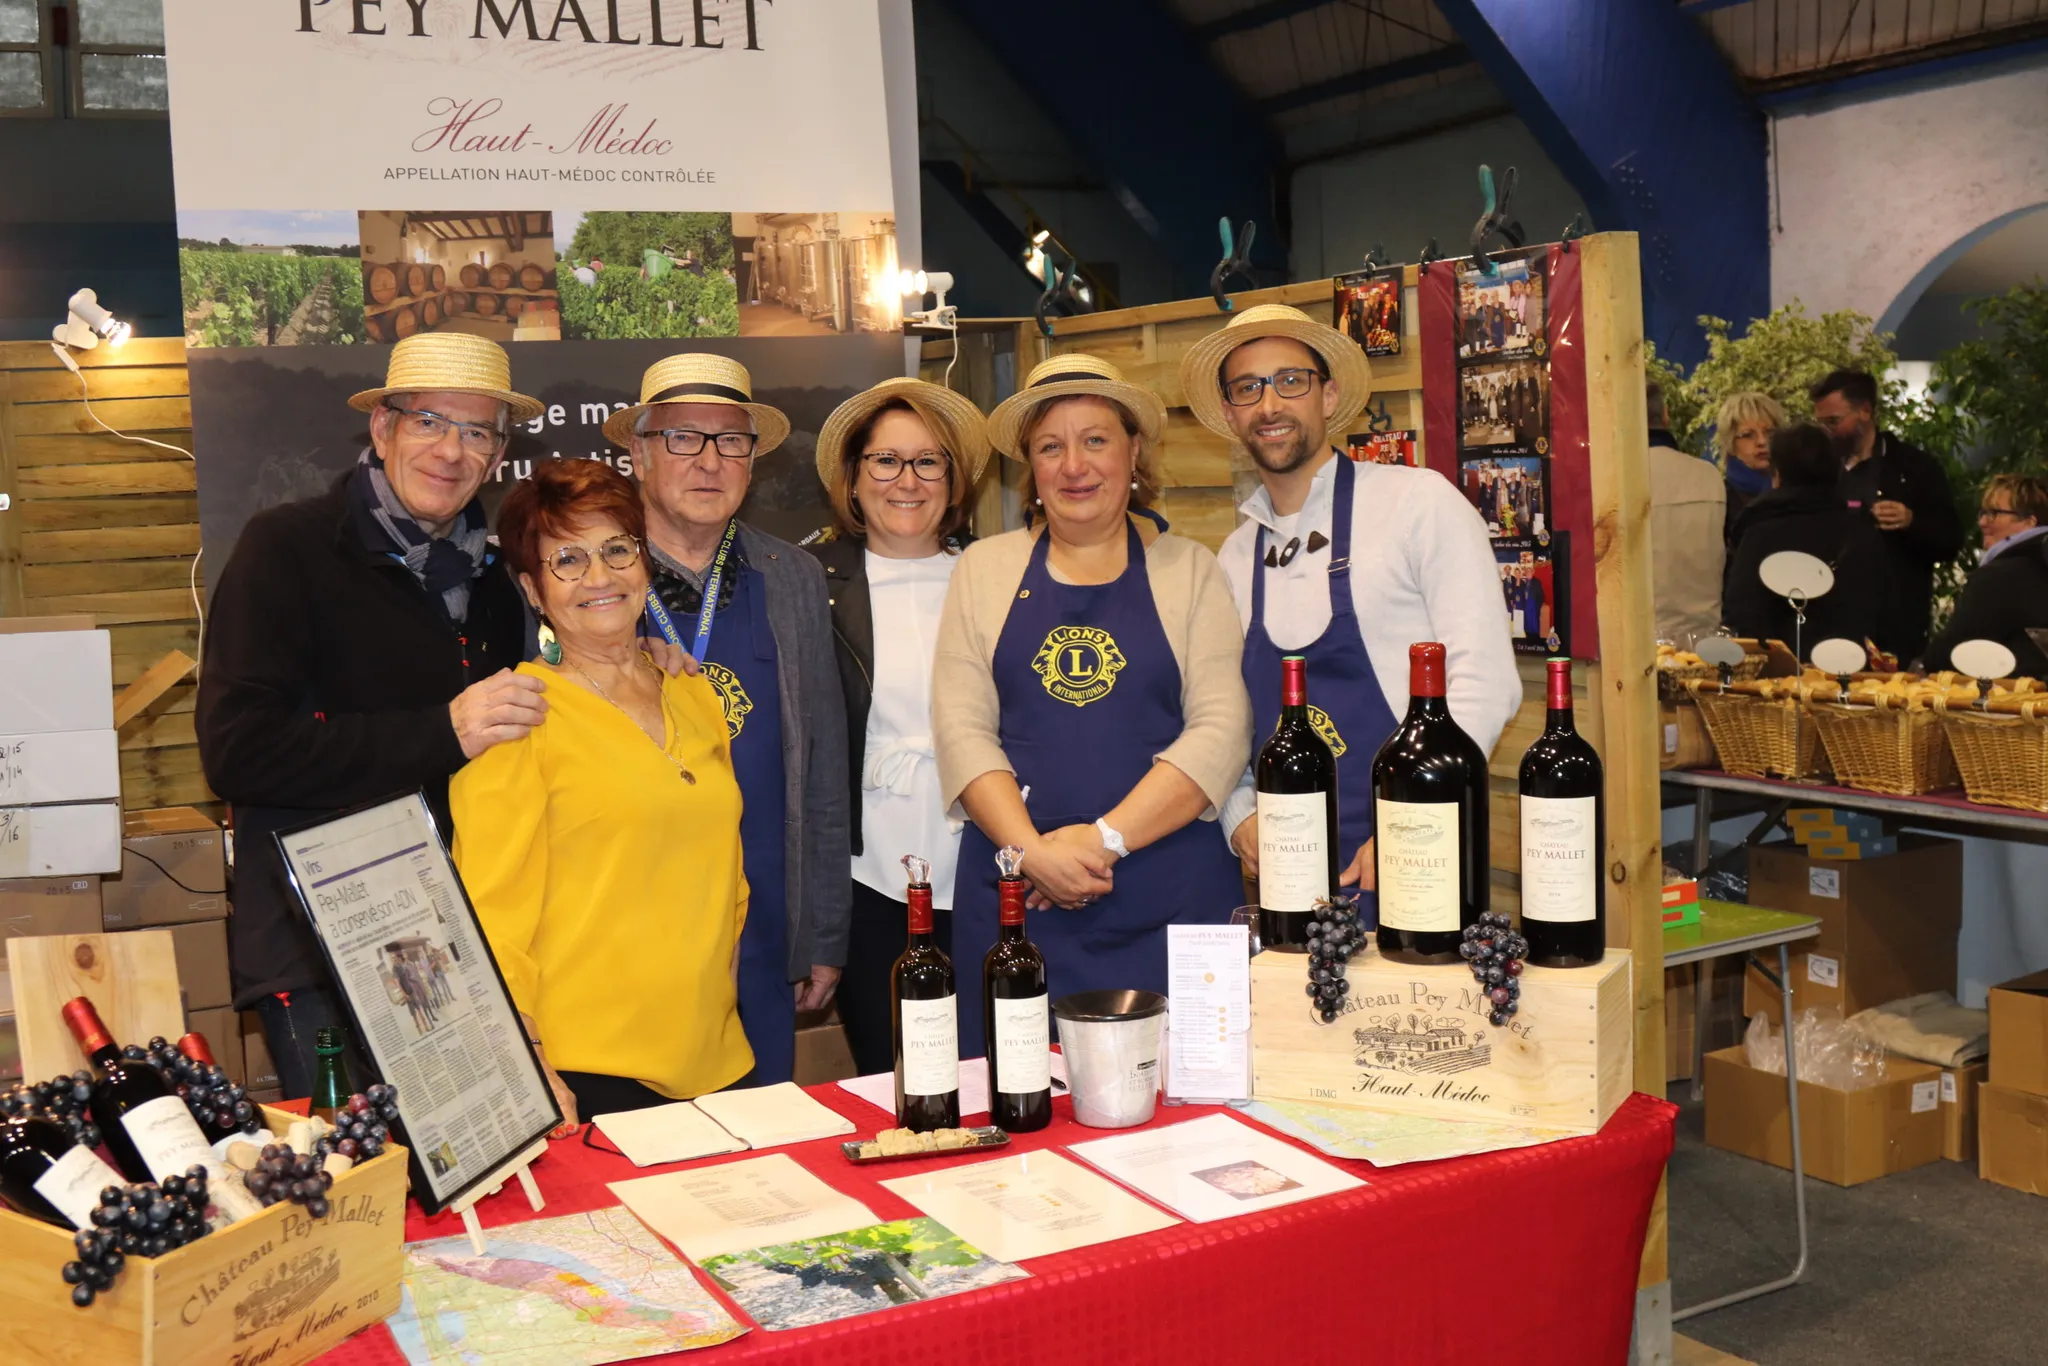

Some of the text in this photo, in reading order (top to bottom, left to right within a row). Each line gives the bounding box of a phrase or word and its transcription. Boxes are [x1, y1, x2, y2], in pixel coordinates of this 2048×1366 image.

[469, 0, 773, 51] MALLET
[383, 165, 716, 184] APPELLATION HAUT-MÉDOC CONTRÔLÉE
[515, 404, 566, 434] ge
[714, 540, 732, 567] CLUBS
[648, 593, 668, 625] CLUBS
[1053, 629, 1105, 643] LIONS
[1068, 649, 1093, 677] L
[1052, 683, 1107, 700] INTERNATIONAL
[1279, 842, 1319, 853] MALLET
[1526, 847, 1586, 860] PEY MALLET
[1384, 854, 1448, 868] PEY MALLET
[1309, 992, 1401, 1027] Câteau
[1408, 981, 1448, 1011] Pey
[1315, 1088, 1337, 1099] DMG
[180, 1194, 386, 1327] Château Pey Mallet
